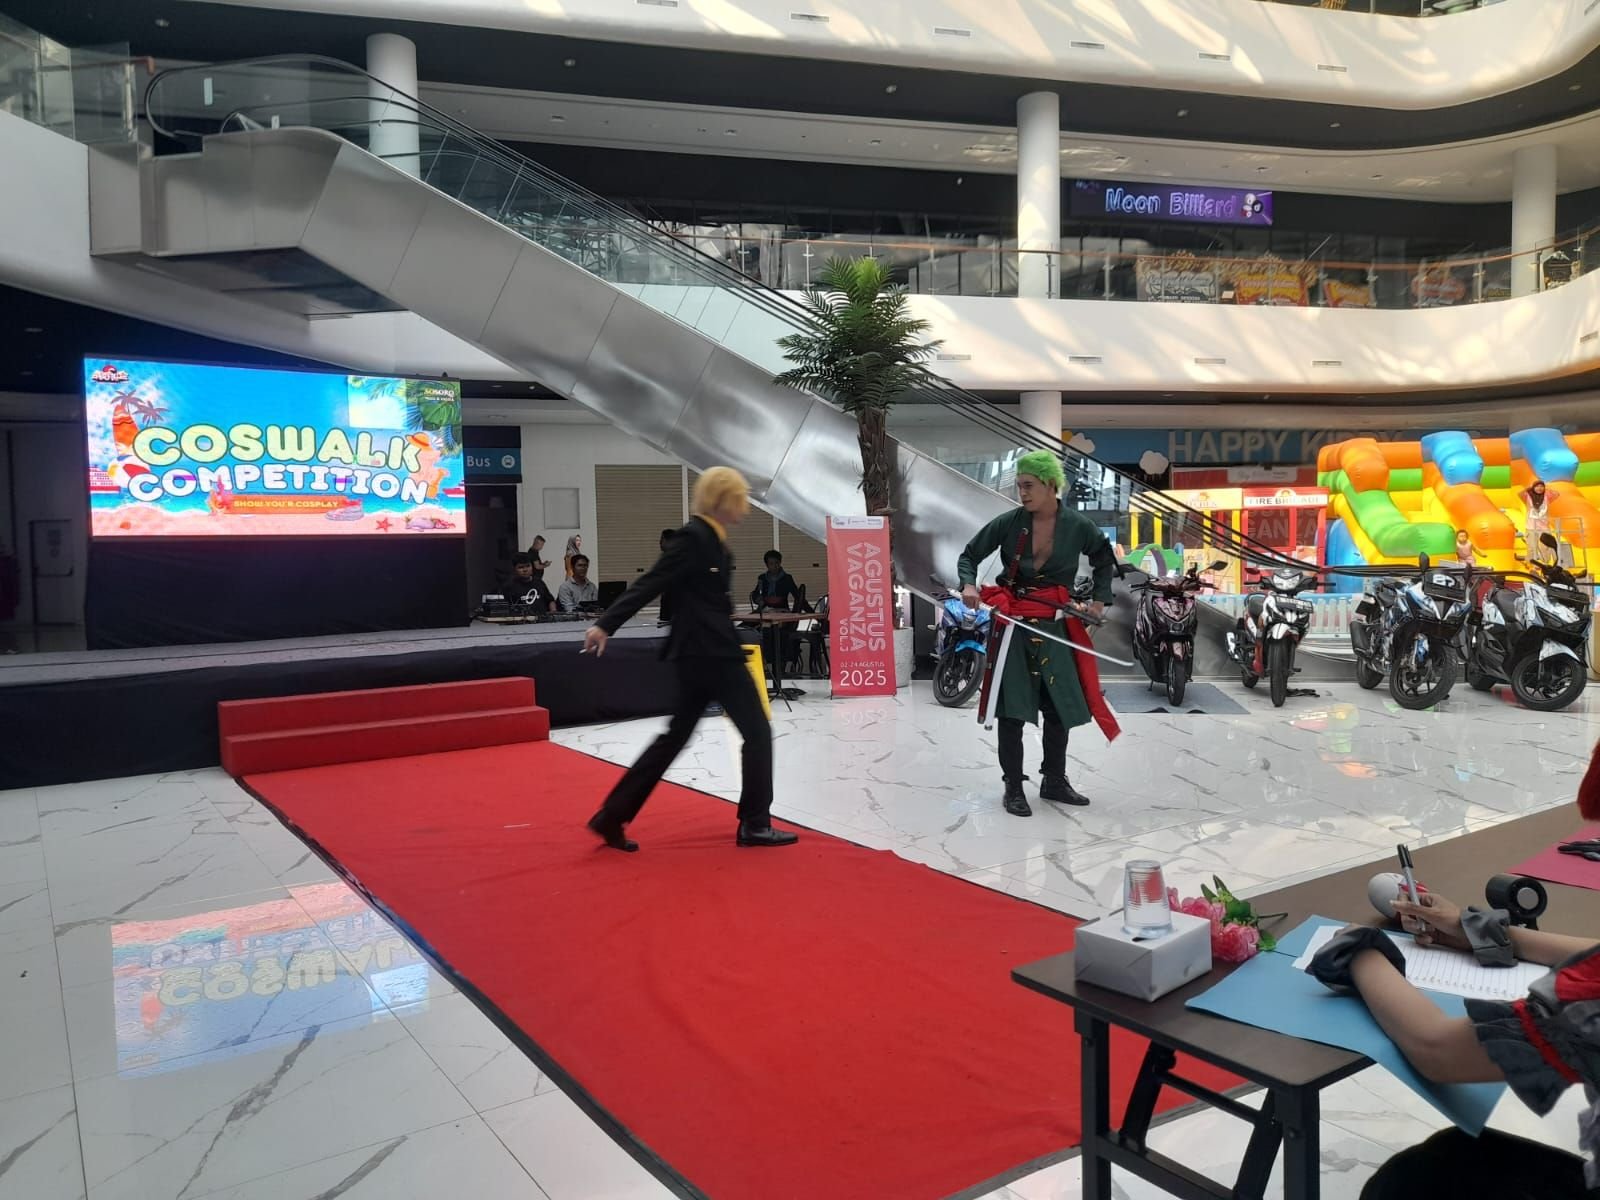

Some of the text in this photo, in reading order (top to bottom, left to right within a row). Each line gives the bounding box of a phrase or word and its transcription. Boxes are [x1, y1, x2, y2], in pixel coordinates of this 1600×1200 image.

[1105, 187, 1237, 218] Moon Billiard
[132, 423, 423, 473] COSWALK
[466, 455, 491, 468] Bus
[1170, 431, 1290, 463] HAPPY
[127, 463, 431, 505] COMPETITION
[846, 541, 867, 652] VAGANZA
[863, 541, 887, 652] AGUSTUS
[839, 669, 887, 687] 2025
